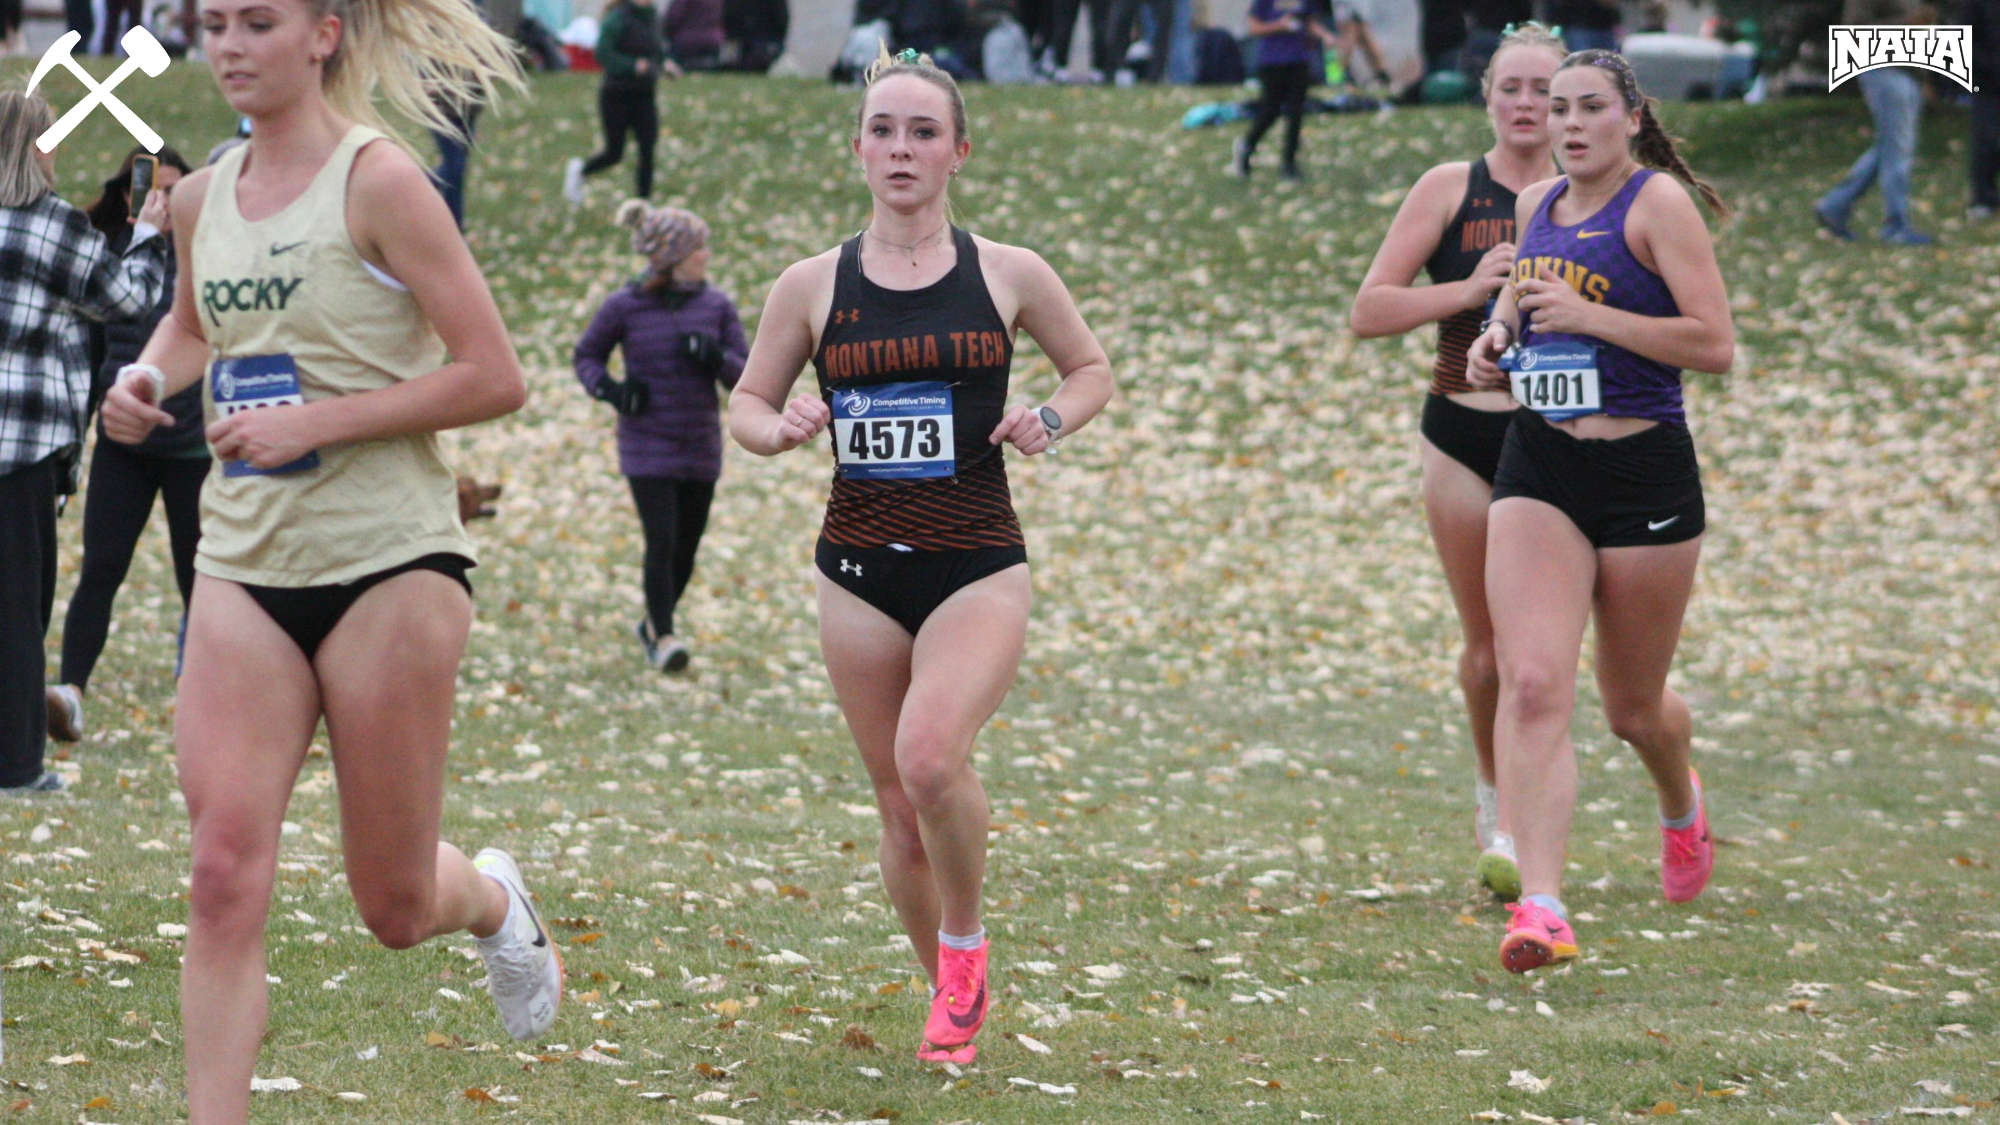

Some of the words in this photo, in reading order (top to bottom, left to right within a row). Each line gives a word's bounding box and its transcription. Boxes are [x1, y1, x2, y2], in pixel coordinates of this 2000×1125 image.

[203, 277, 304, 327] ROCKY
[824, 334, 939, 379] MONTANA
[949, 331, 1005, 368] TECH
[872, 397, 918, 407] Competitive
[1520, 372, 1584, 406] 1401
[849, 418, 941, 460] 4573
